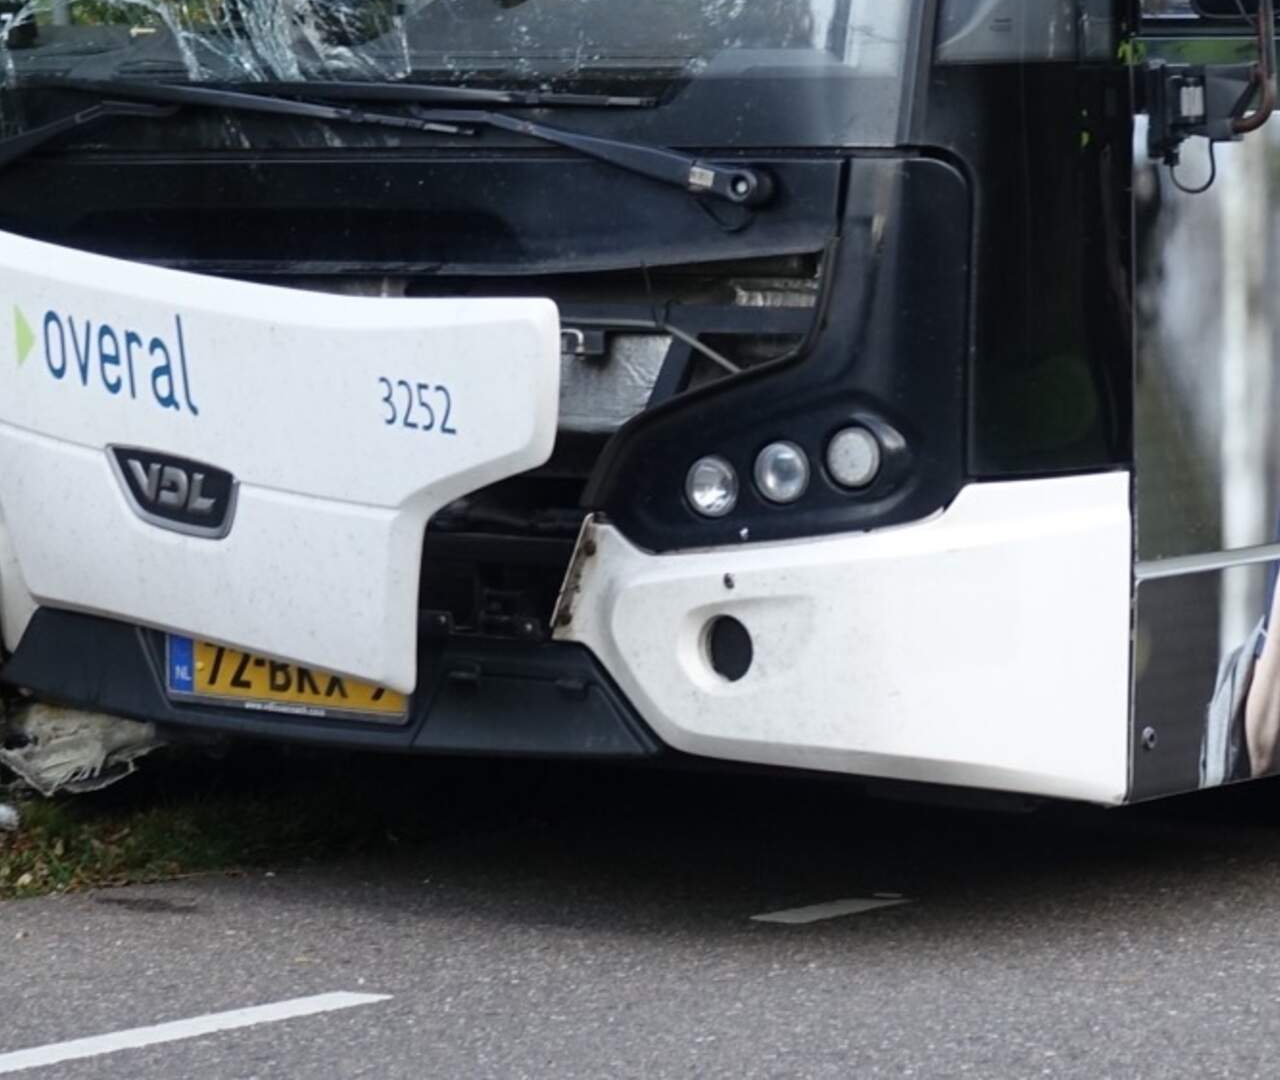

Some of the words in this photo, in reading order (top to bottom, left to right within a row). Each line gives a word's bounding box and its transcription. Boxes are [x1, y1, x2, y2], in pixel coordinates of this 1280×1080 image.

[42, 311, 199, 417] overal
[378, 376, 458, 435] 3252
[125, 460, 217, 513] VDL
[175, 664, 192, 681] NL
